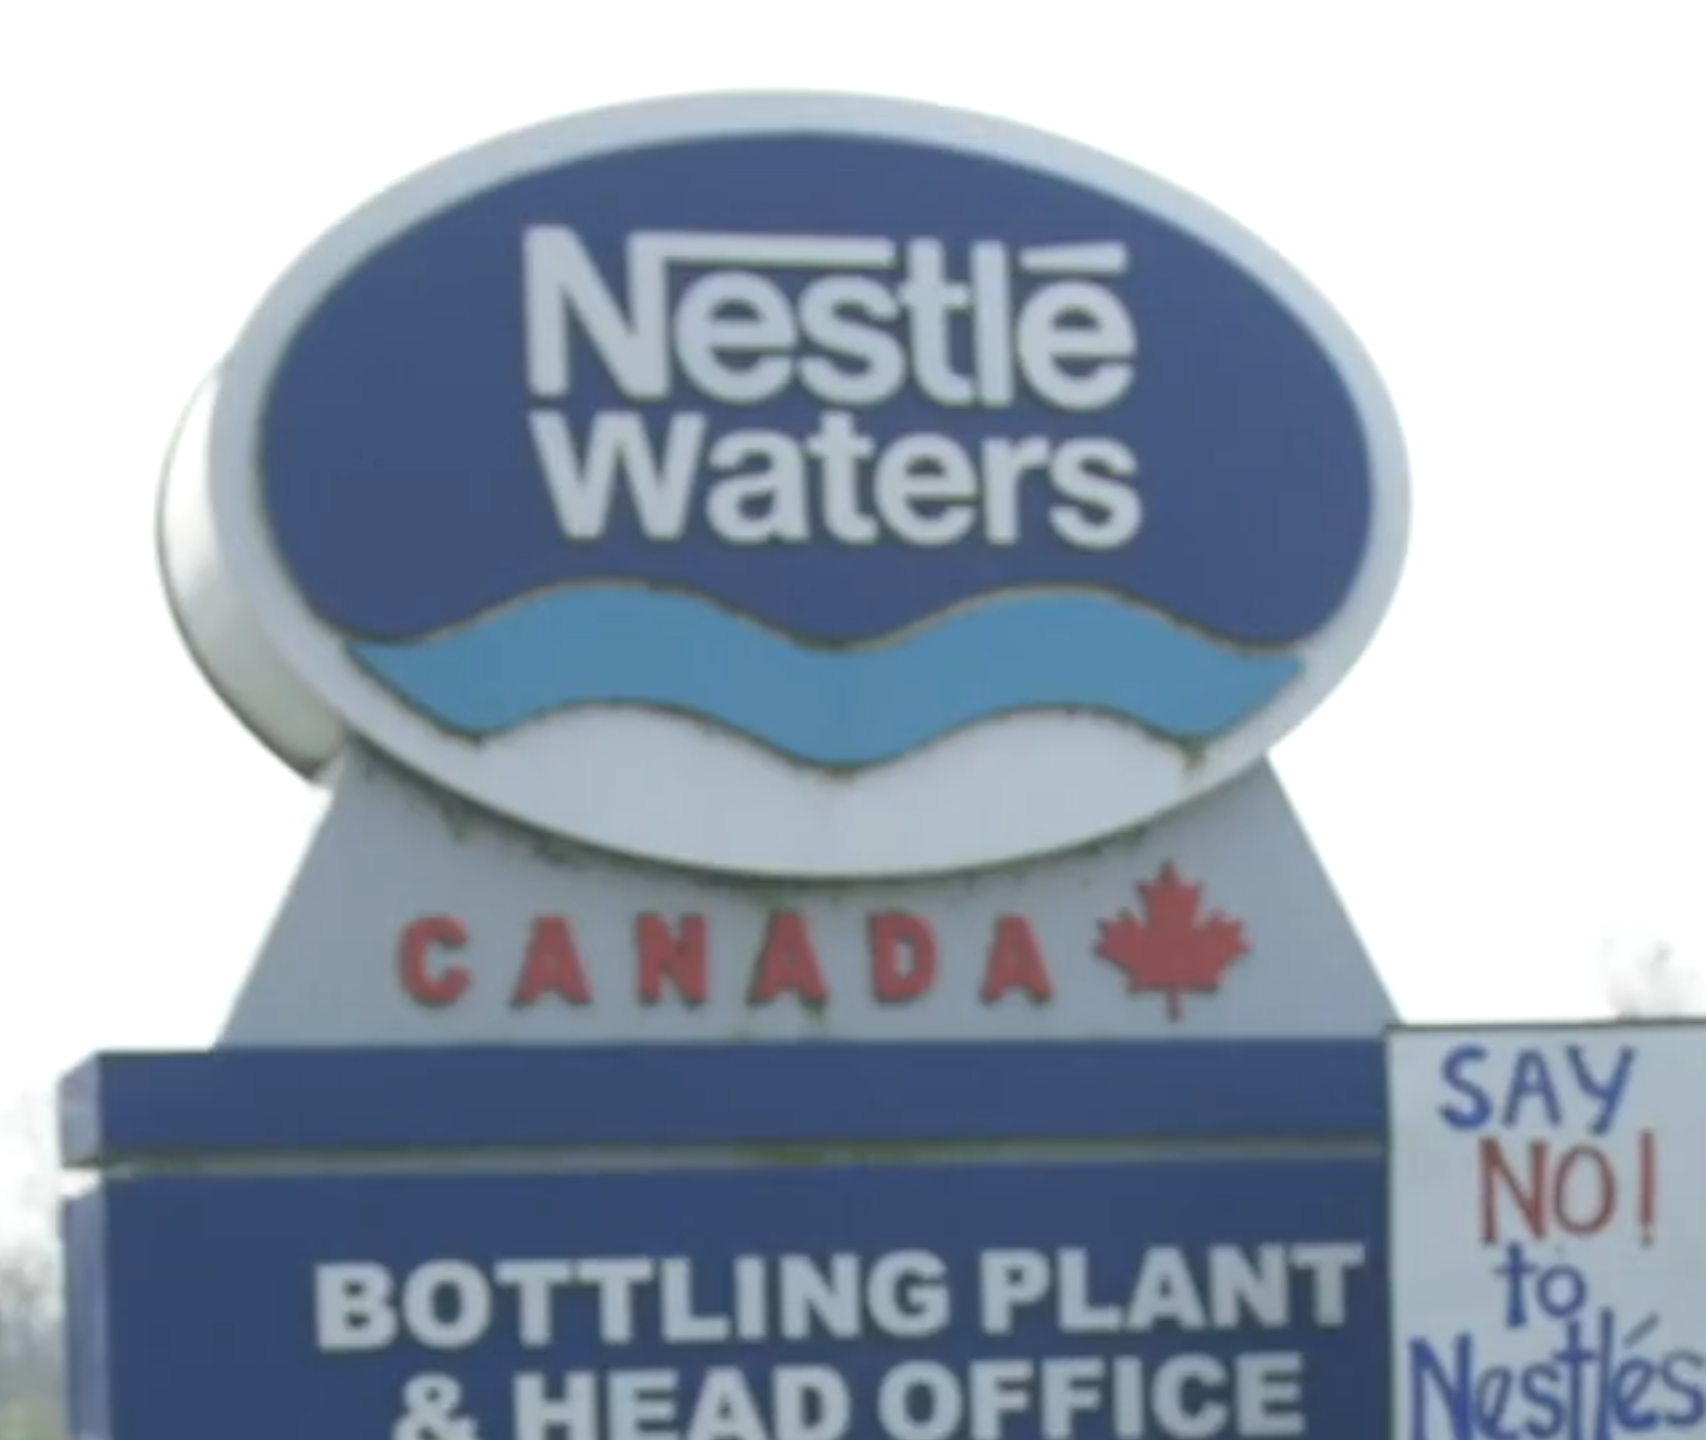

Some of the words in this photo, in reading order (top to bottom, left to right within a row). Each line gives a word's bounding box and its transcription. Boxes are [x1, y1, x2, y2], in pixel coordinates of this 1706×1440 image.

[522, 226, 1138, 408] Nestlé
[528, 410, 1143, 550] Waters
[397, 911, 1056, 1006] CANADA
[1438, 1043, 1635, 1135] SAY
[1478, 1129, 1658, 1249] NO!
[314, 1251, 949, 1351] BOTTLING
[980, 1242, 1366, 1334] PLANT
[1492, 1240, 1587, 1330] to
